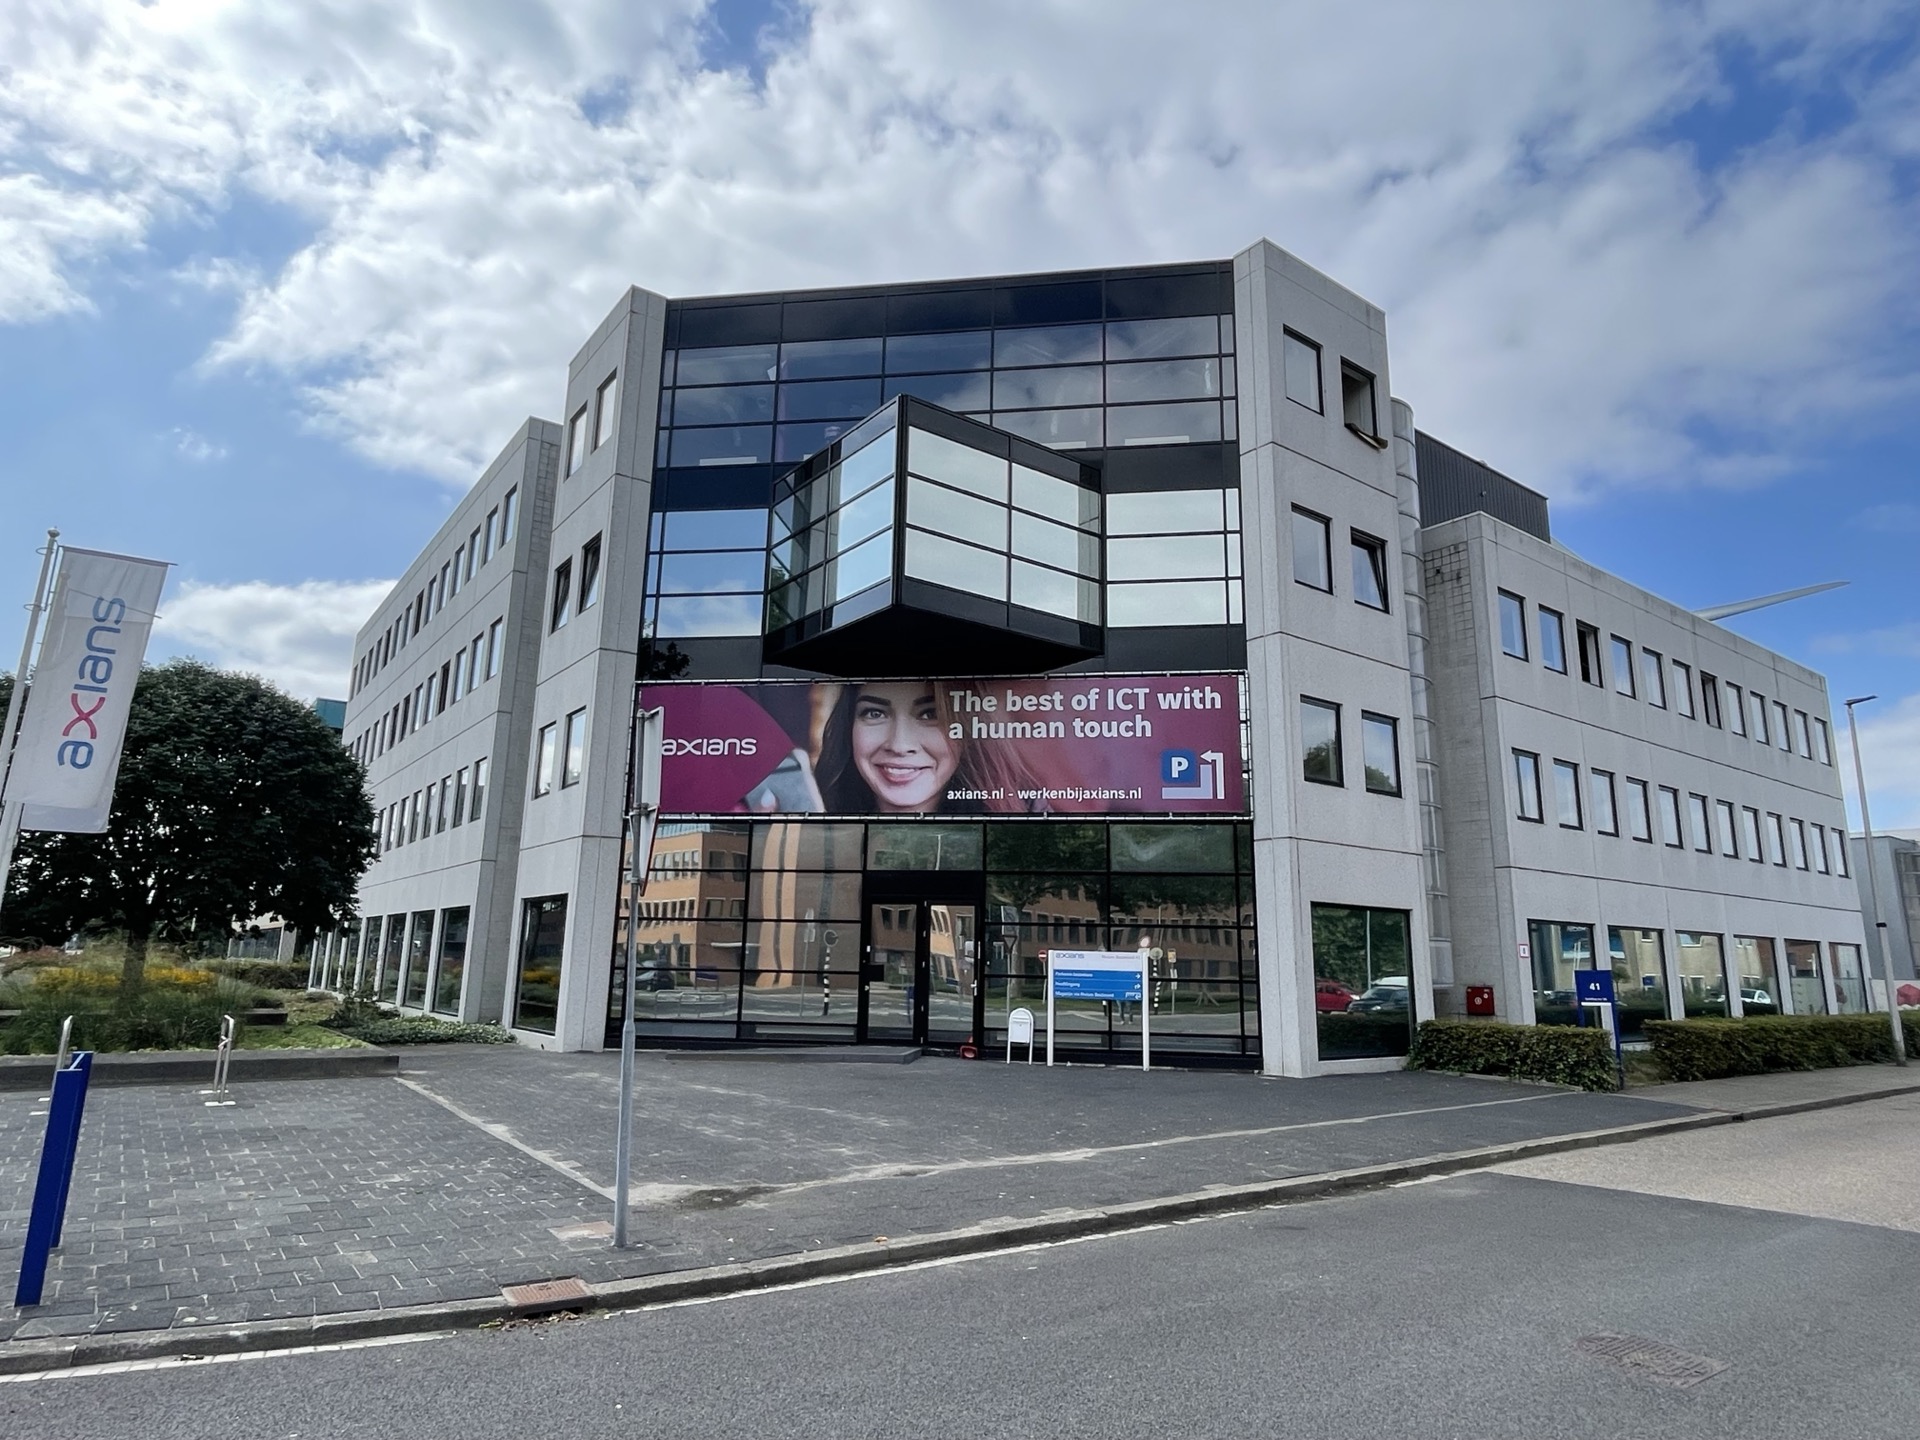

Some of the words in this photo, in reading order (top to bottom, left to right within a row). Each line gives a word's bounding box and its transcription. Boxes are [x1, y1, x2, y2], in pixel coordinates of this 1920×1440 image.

[57, 596, 126, 770] axians
[950, 690, 997, 712] The
[1006, 689, 1064, 712] best
[1071, 687, 1100, 711] of
[1107, 687, 1149, 711] ICT
[1157, 686, 1222, 710] with
[948, 722, 963, 739] a
[972, 717, 1065, 739] human
[1073, 714, 1152, 738] touch
[661, 738, 757, 756] axians
[1171, 756, 1189, 778] P
[947, 787, 1004, 800] axians.nl
[1017, 787, 1142, 802] werkenbijaxians.nl
[1589, 982, 1601, 991] 41
